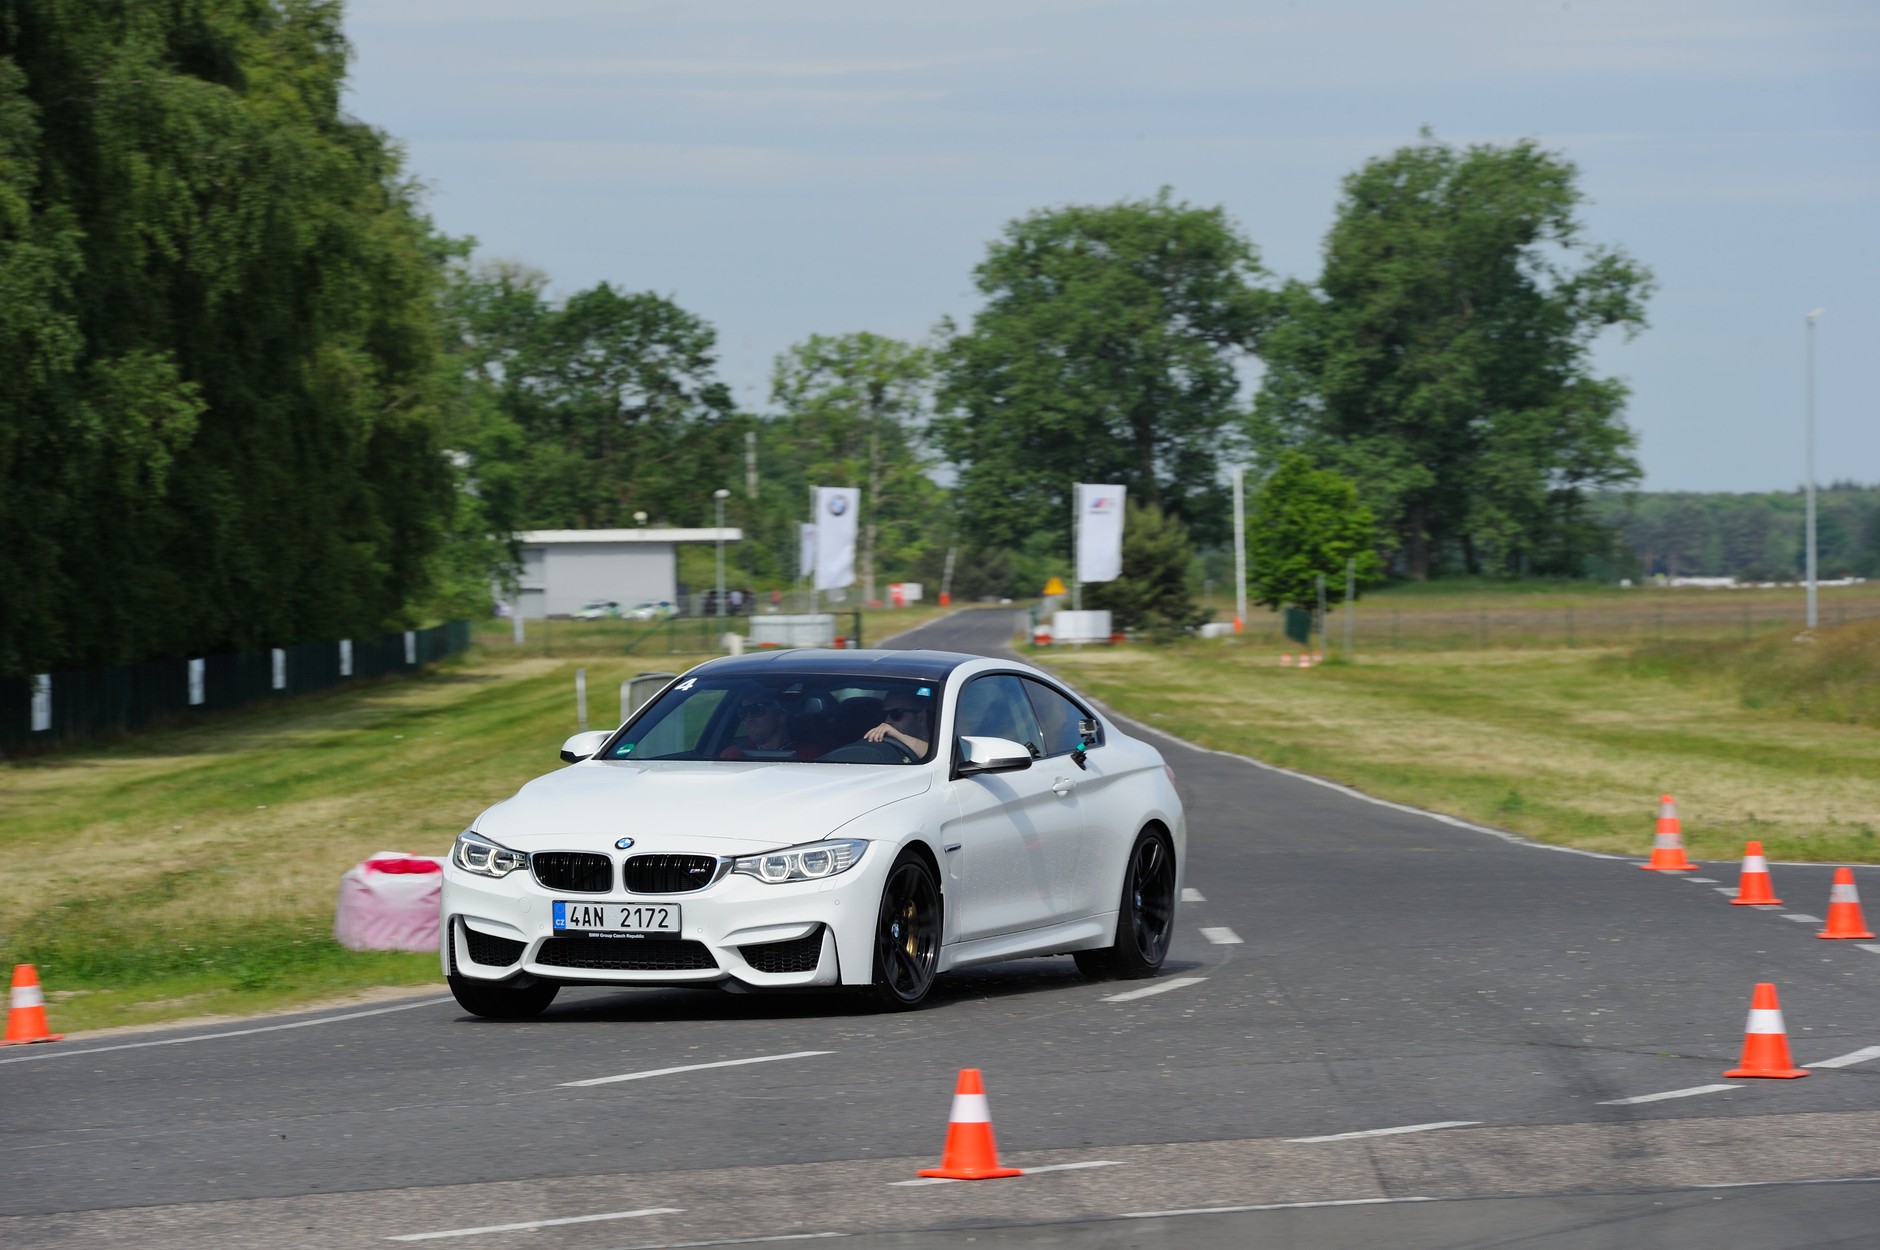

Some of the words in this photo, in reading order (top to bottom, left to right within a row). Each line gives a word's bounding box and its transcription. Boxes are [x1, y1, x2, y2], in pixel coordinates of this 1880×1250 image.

[675, 678, 698, 691] 4
[555, 918, 565, 926] CZ
[570, 906, 604, 927] 4AN
[620, 908, 669, 928] 2172
